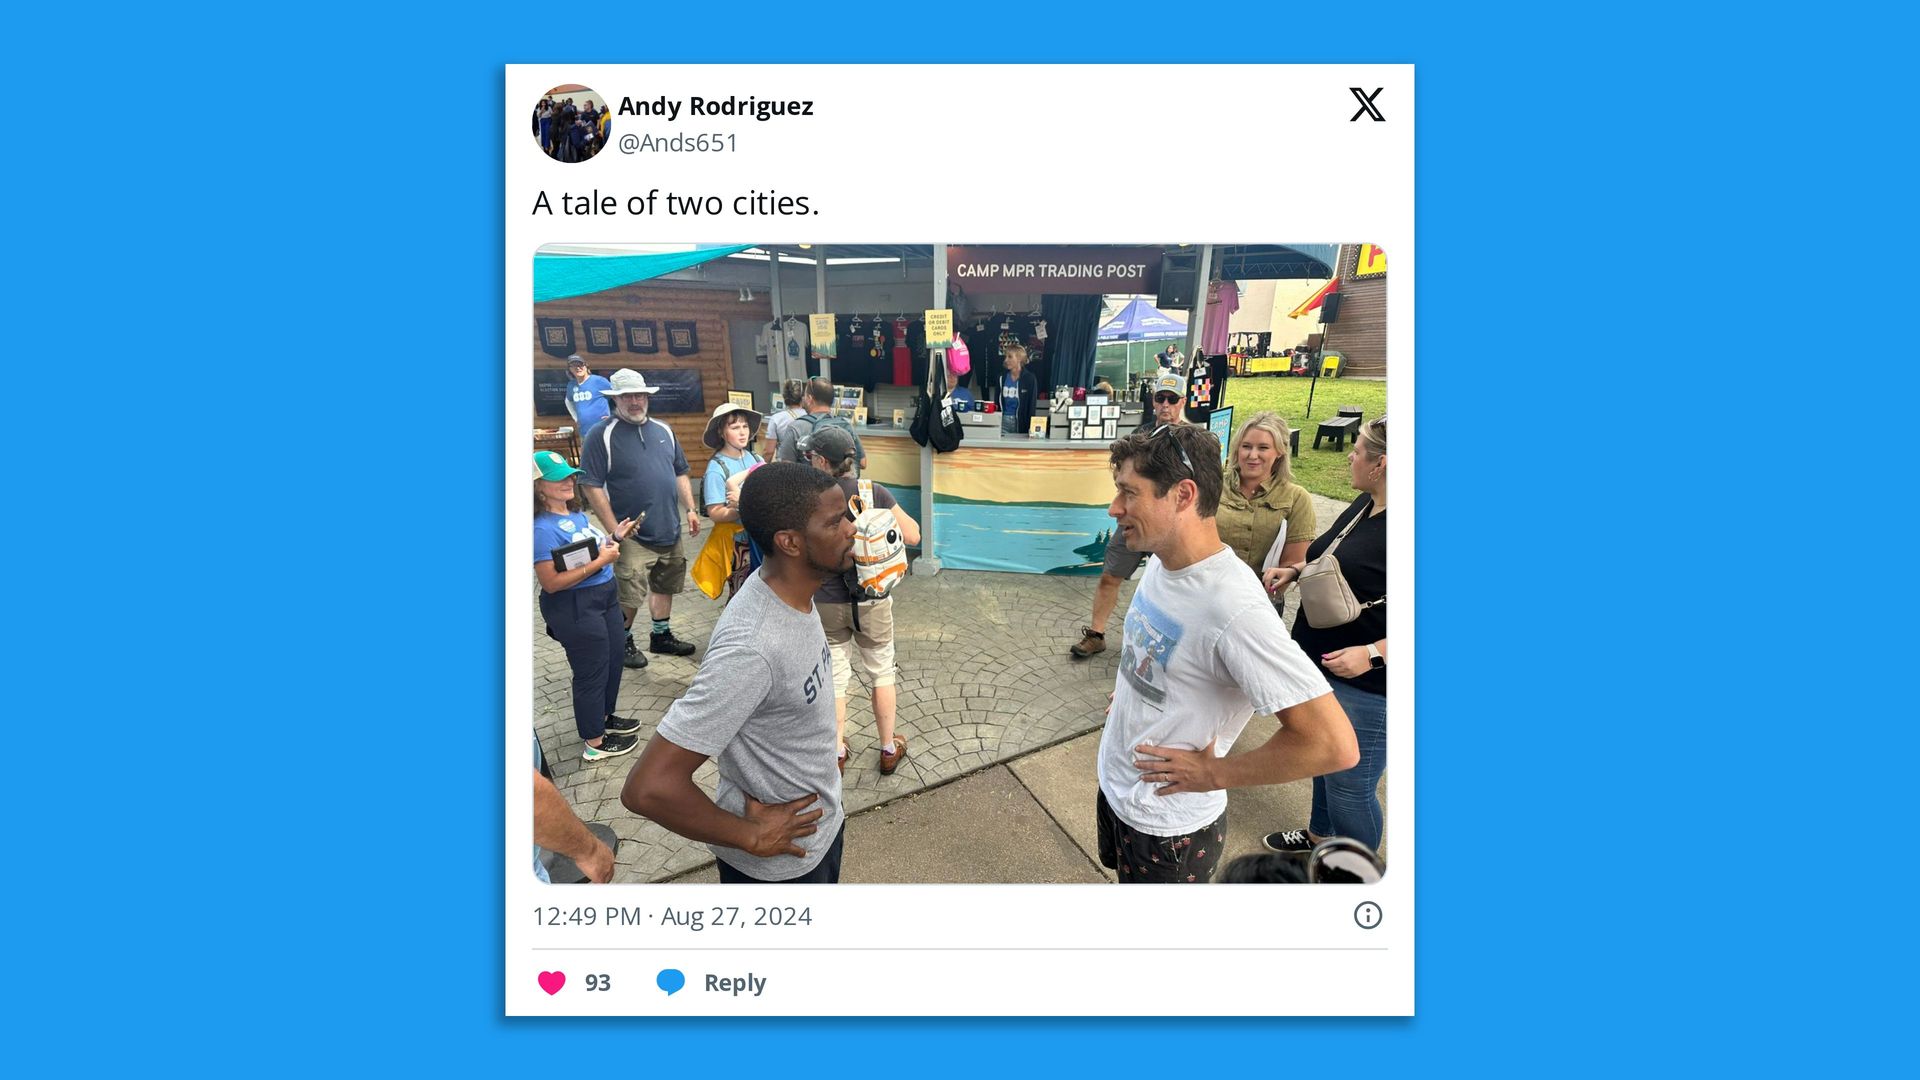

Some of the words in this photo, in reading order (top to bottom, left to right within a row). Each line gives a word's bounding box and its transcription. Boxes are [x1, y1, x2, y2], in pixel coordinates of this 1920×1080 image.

[957, 263, 1000, 278] CAMP
[1003, 264, 1035, 278] MPR
[1038, 264, 1104, 279] TRADING
[1106, 264, 1147, 279] POST
[803, 663, 824, 704] ST.
